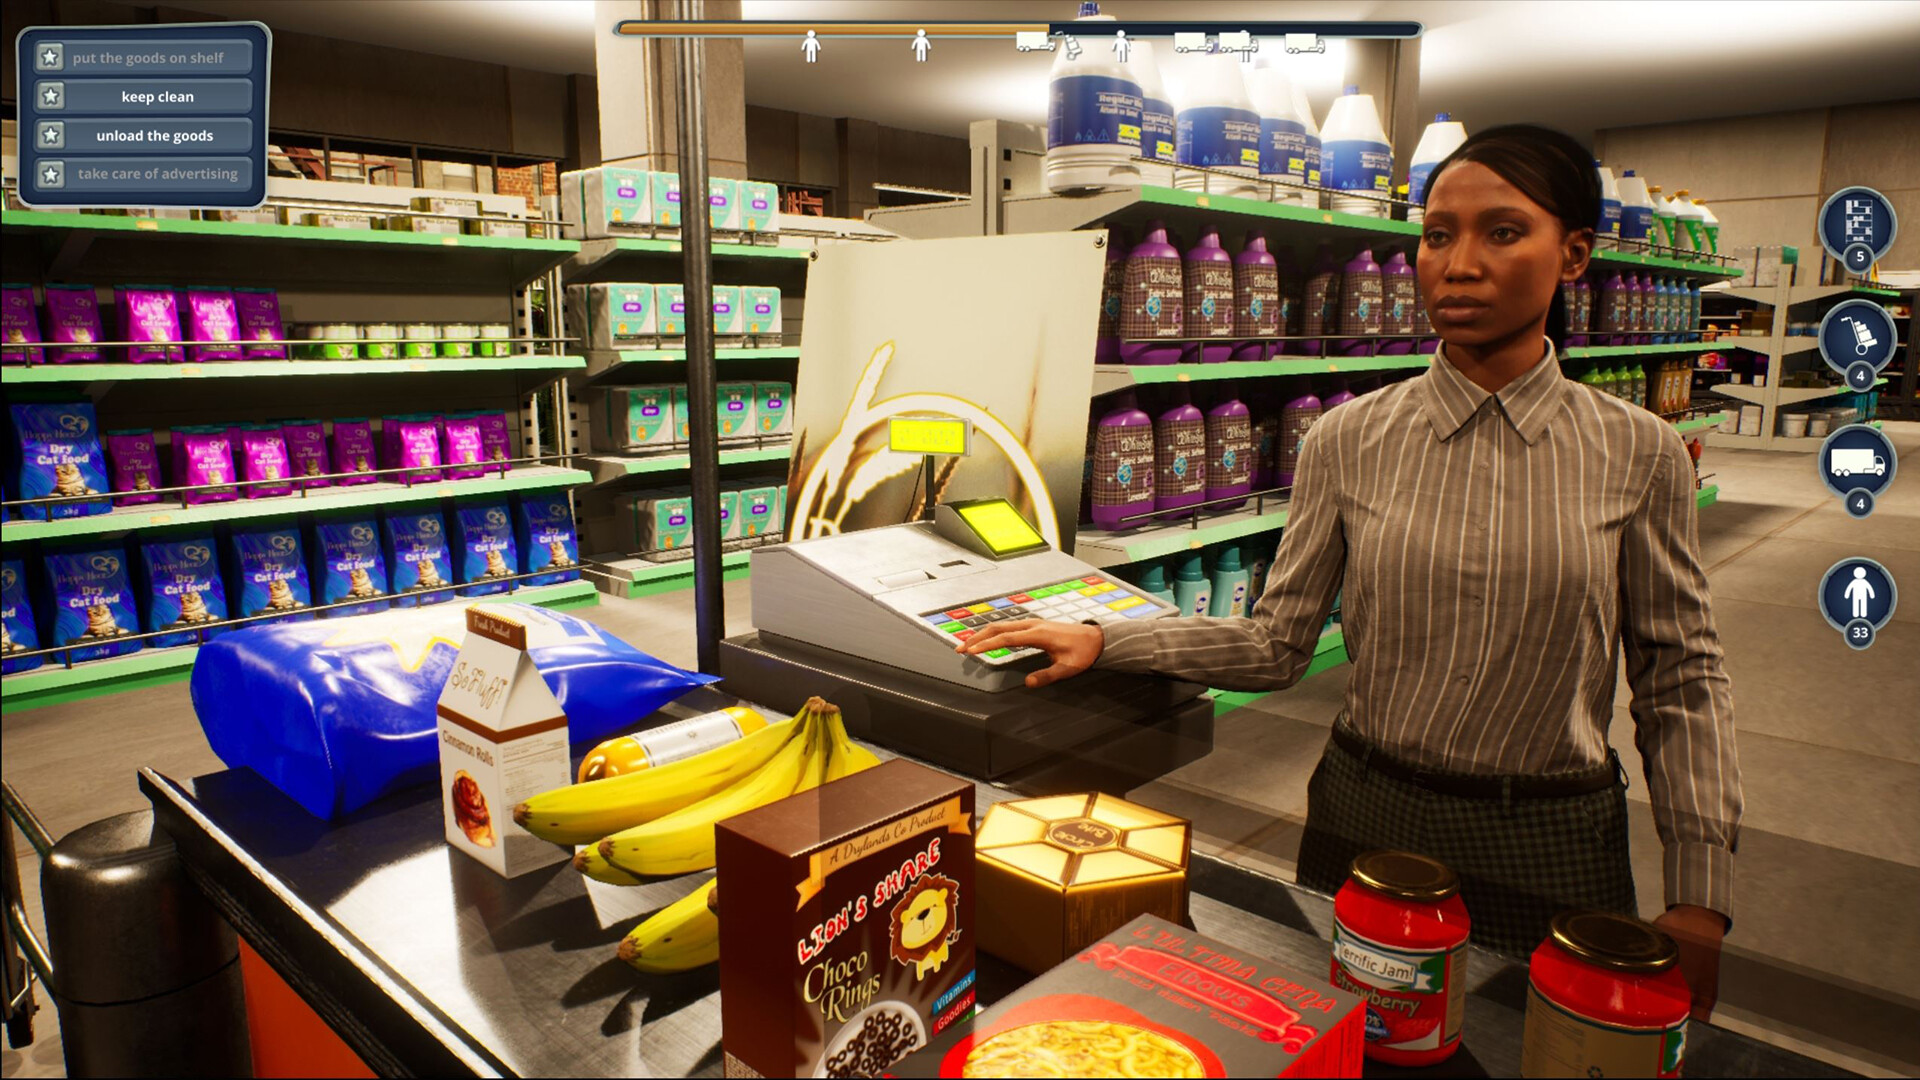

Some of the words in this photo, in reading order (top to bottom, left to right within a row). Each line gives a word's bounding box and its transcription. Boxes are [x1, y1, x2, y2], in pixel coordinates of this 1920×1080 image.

[73, 53, 96, 67] put
[100, 52, 123, 64] the
[126, 52, 166, 67] goods
[170, 55, 187, 64] on
[190, 51, 224, 64] shelf
[122, 91, 154, 105] keep
[158, 91, 194, 103] clean
[96, 130, 144, 142] unload
[147, 130, 170, 142] the
[173, 130, 214, 145] goods
[78, 168, 108, 180] take
[112, 171, 141, 180] care
[144, 168, 159, 180] of
[162, 168, 239, 183] advertising
[1857, 251, 1864, 262] 5
[1856, 370, 1865, 381] 4
[50, 444, 74, 455] Dry
[37, 455, 59, 465] Cat
[62, 453, 90, 464] food
[1856, 498, 1865, 509] 4
[345, 552, 363, 561] Dry
[404, 553, 420, 562] Cat
[264, 562, 284, 572] Dry
[336, 562, 353, 572] Cat
[354, 559, 375, 569] food
[175, 574, 196, 584] Dry
[254, 572, 272, 583] Cat
[273, 569, 297, 581] food
[82, 585, 104, 597] Dry
[164, 584, 184, 595] Cat
[186, 581, 211, 593] food
[69, 597, 90, 609] Cat
[93, 593, 120, 605] food
[1853, 627, 1868, 638] 33
[443, 729, 475, 758] Cinnamon
[476, 744, 494, 767] Rolls
[830, 852, 839, 866] A
[843, 831, 890, 859] Drylands
[893, 822, 906, 840] Co
[909, 807, 946, 834] Product
[797, 894, 868, 965] LION'S
[873, 837, 941, 909] SHARE
[803, 951, 868, 1003] Choco
[1377, 963, 1415, 982] Jam!
[936, 975, 972, 1010] Vitamins
[1157, 962, 1254, 1010] Elbows
[820, 973, 881, 1024] Rings
[937, 996, 971, 1030] Goodies
